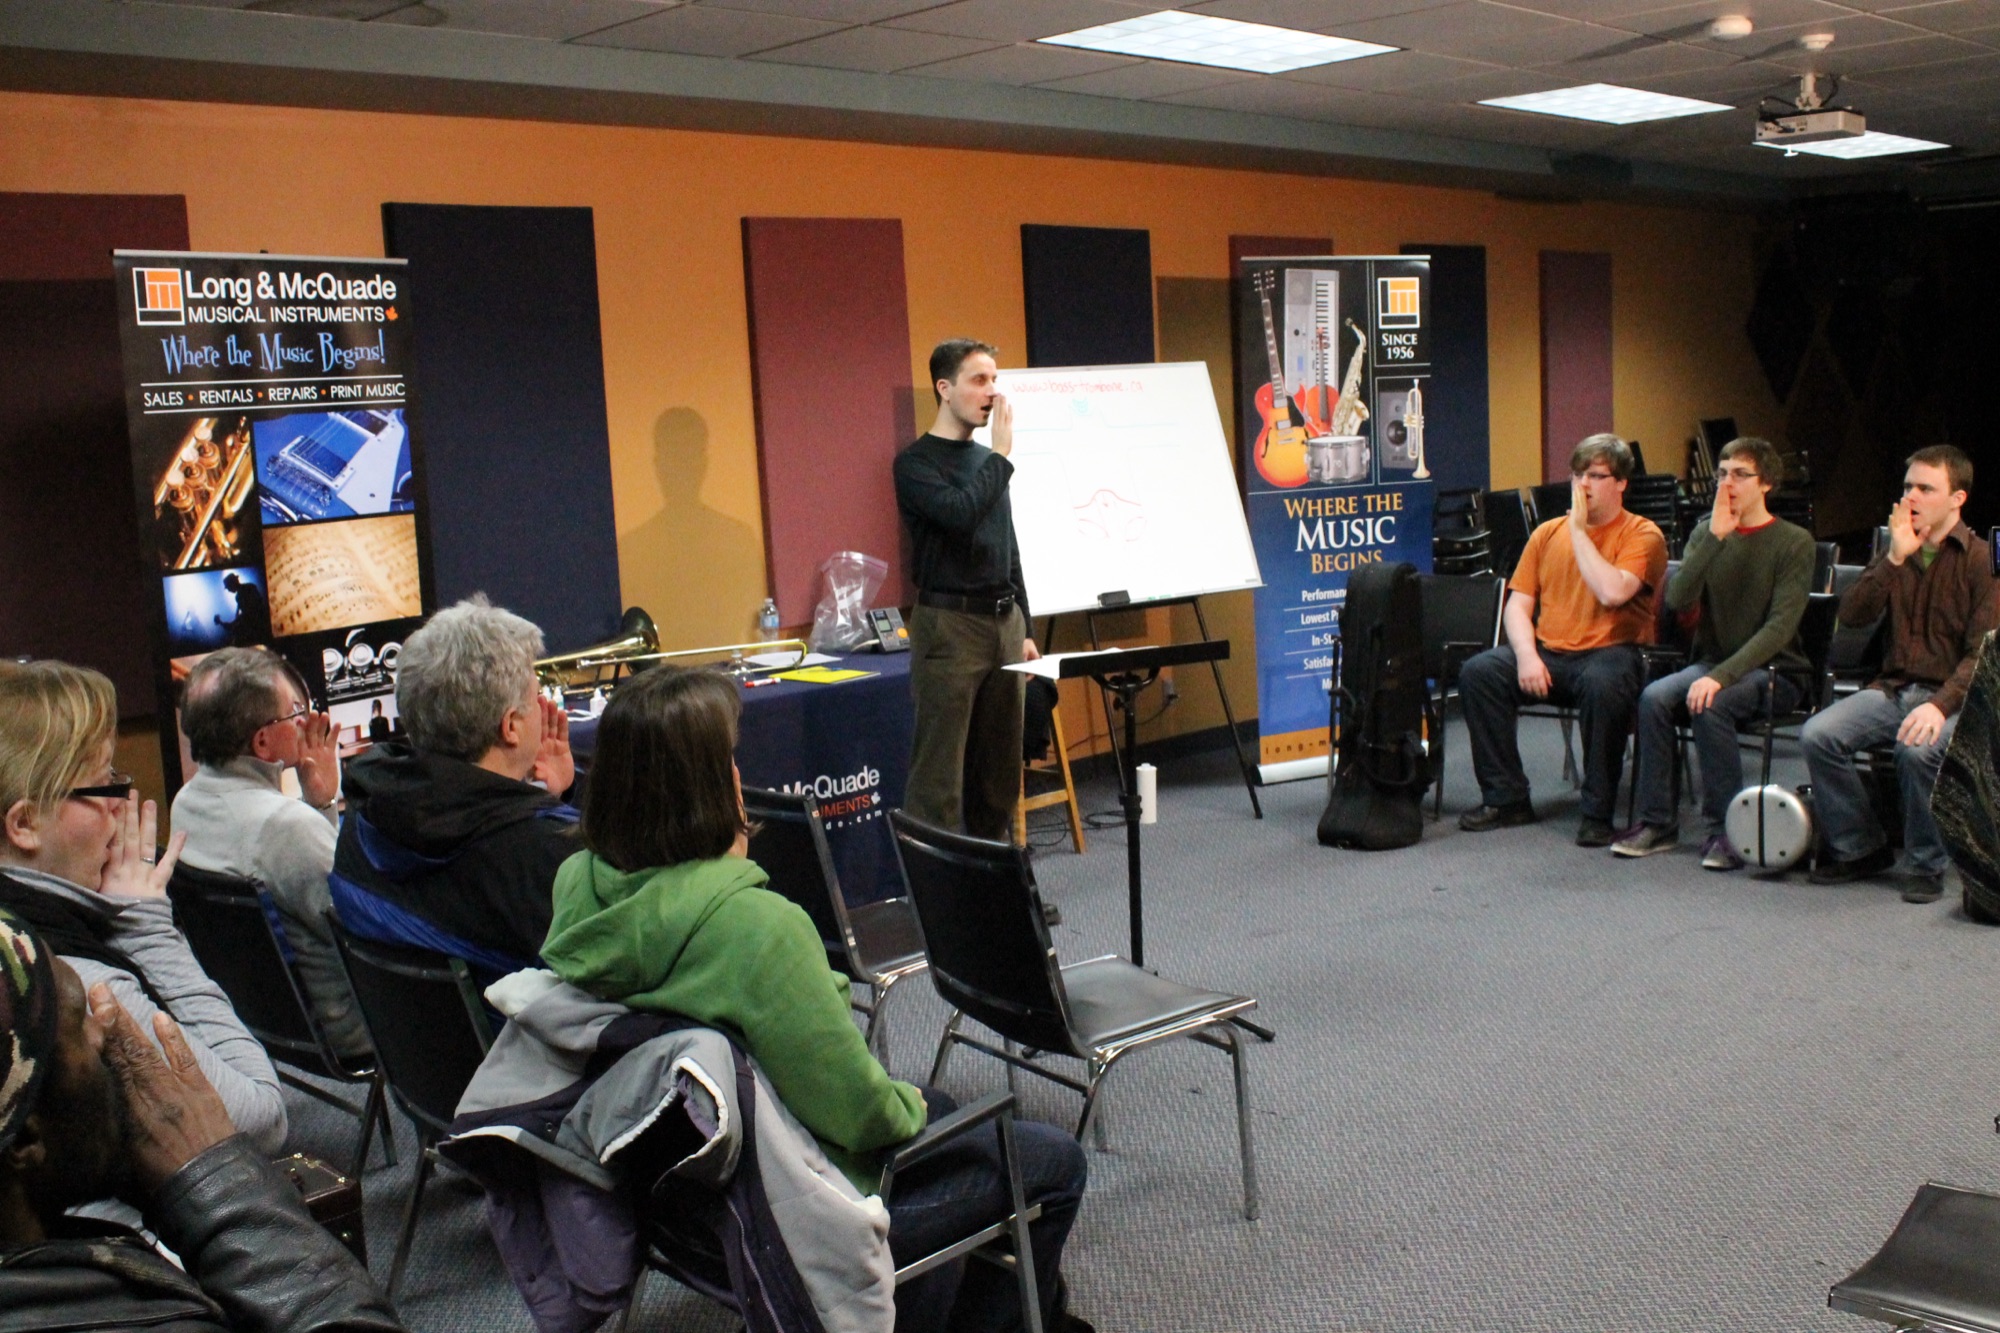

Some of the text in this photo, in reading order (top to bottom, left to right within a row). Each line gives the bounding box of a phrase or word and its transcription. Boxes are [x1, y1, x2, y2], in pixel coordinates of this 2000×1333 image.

[185, 270, 396, 305] Long & McQuade
[188, 306, 385, 323] MUSICAL INSTRUMENTS
[160, 328, 386, 375] Where the Music Begins!
[1381, 333, 1418, 346] SINCE
[1386, 346, 1415, 360] 1956
[144, 383, 405, 407] SALES RENTALS REPAIRS PRINT MUSIC
[1283, 492, 1404, 519] WHERE THE
[1295, 515, 1396, 552] MUSIC
[1301, 611, 1330, 625] Lowest
